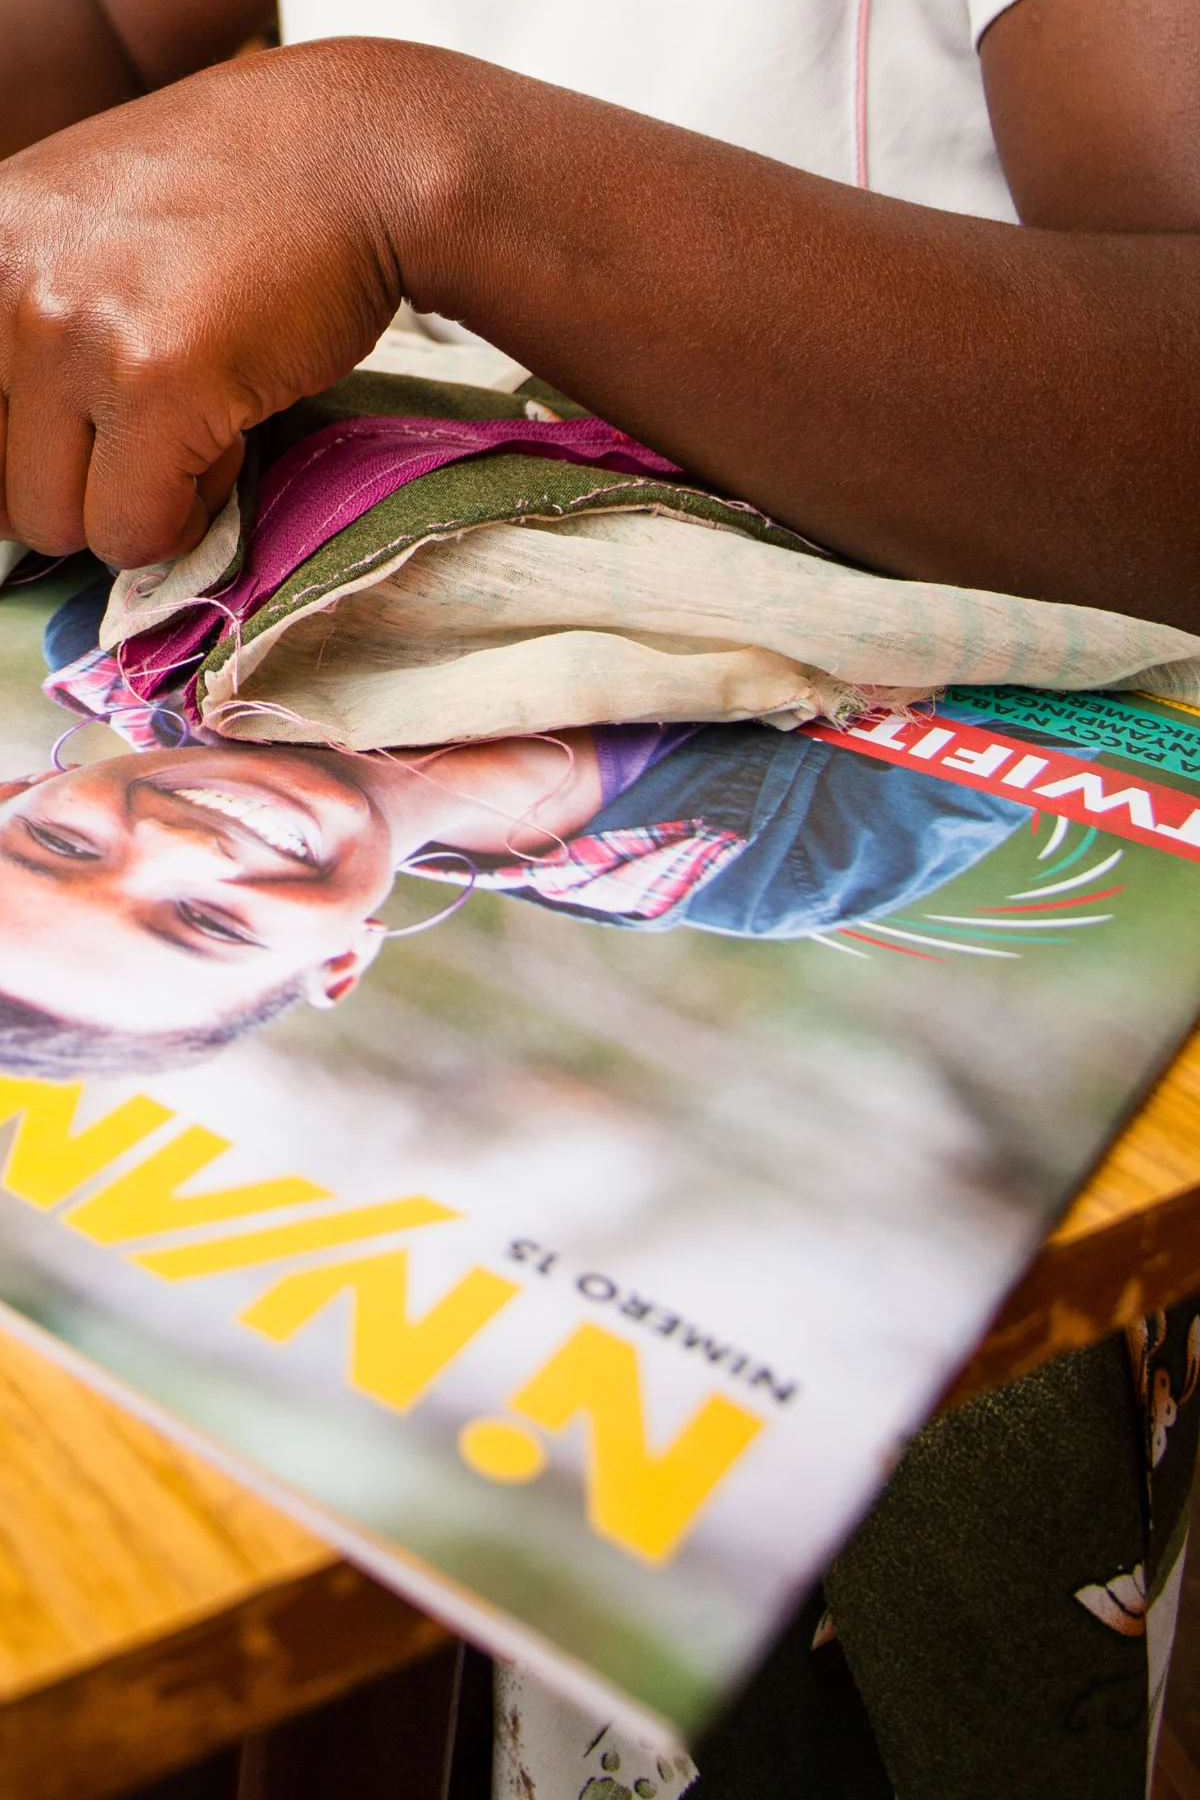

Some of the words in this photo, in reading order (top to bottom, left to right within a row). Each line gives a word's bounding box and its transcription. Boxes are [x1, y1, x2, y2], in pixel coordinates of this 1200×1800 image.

[951, 689, 1052, 728] N'ABA
[1057, 724, 1170, 763] PACCY
[812, 713, 1200, 848] TWIFIT
[508, 1237, 558, 1276] 15
[574, 1272, 799, 1404] NIMERO
